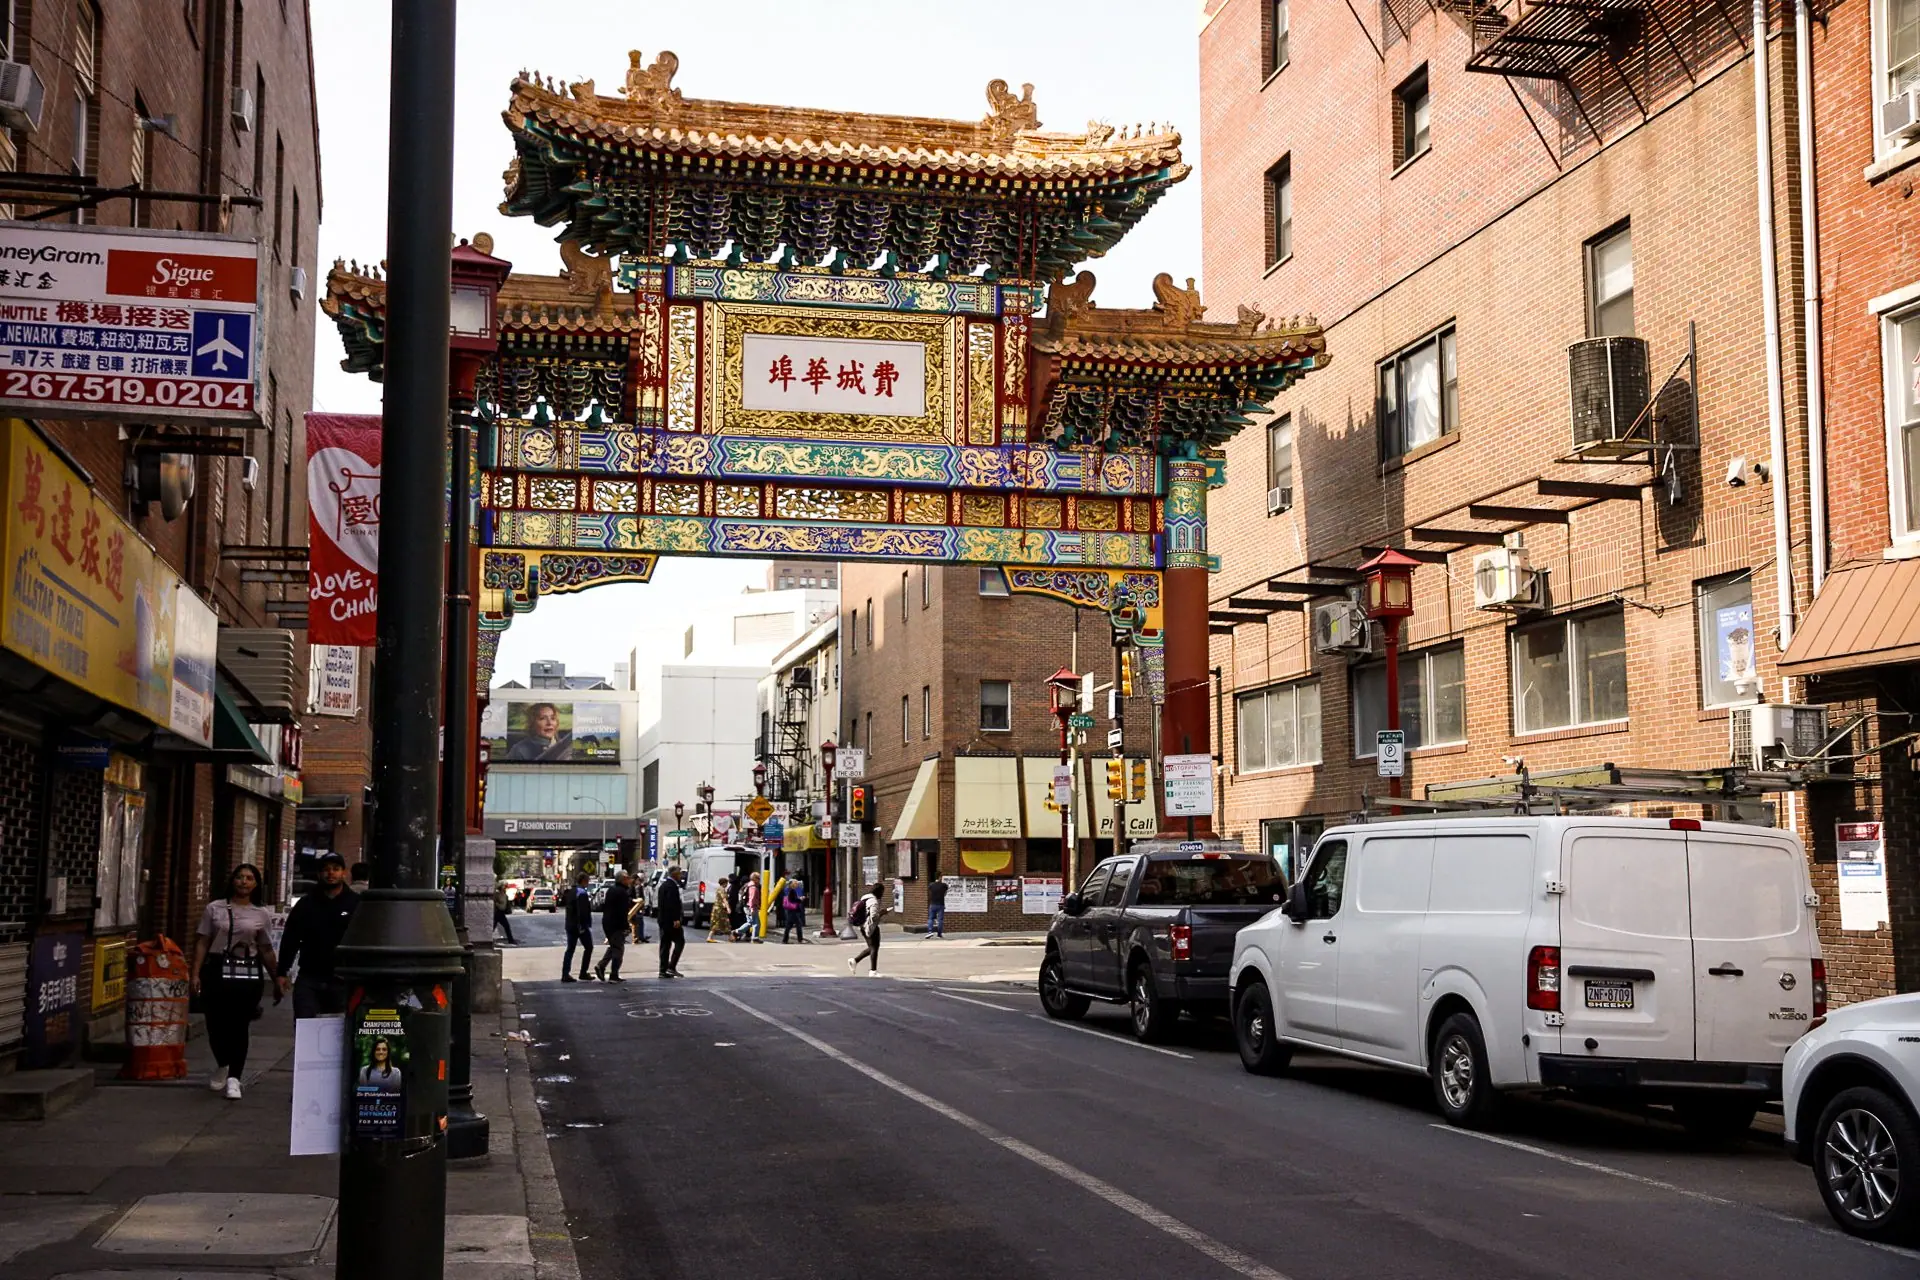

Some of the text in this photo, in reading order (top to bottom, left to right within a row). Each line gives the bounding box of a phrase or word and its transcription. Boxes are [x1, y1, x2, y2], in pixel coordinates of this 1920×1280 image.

[0, 246, 104, 265] neyGram.
[152, 259, 214, 287] Sigue
[0, 305, 47, 321] HUTTLE
[56, 301, 190, 330] 機場接送
[61, 353, 90, 370] 旅遊
[96, 355, 124, 372] 包車
[131, 357, 188, 376] 打折機票
[5, 372, 248, 408] 267.519.0204
[343, 528, 378, 536] CHINAT
[330, 587, 378, 622] CHIN
[1067, 718, 1085, 727] RCH
[518, 822, 572, 830] FASHION DISTRICT
[1130, 818, 1153, 829] Cali
[1769, 1012, 1808, 1020] NV2500
